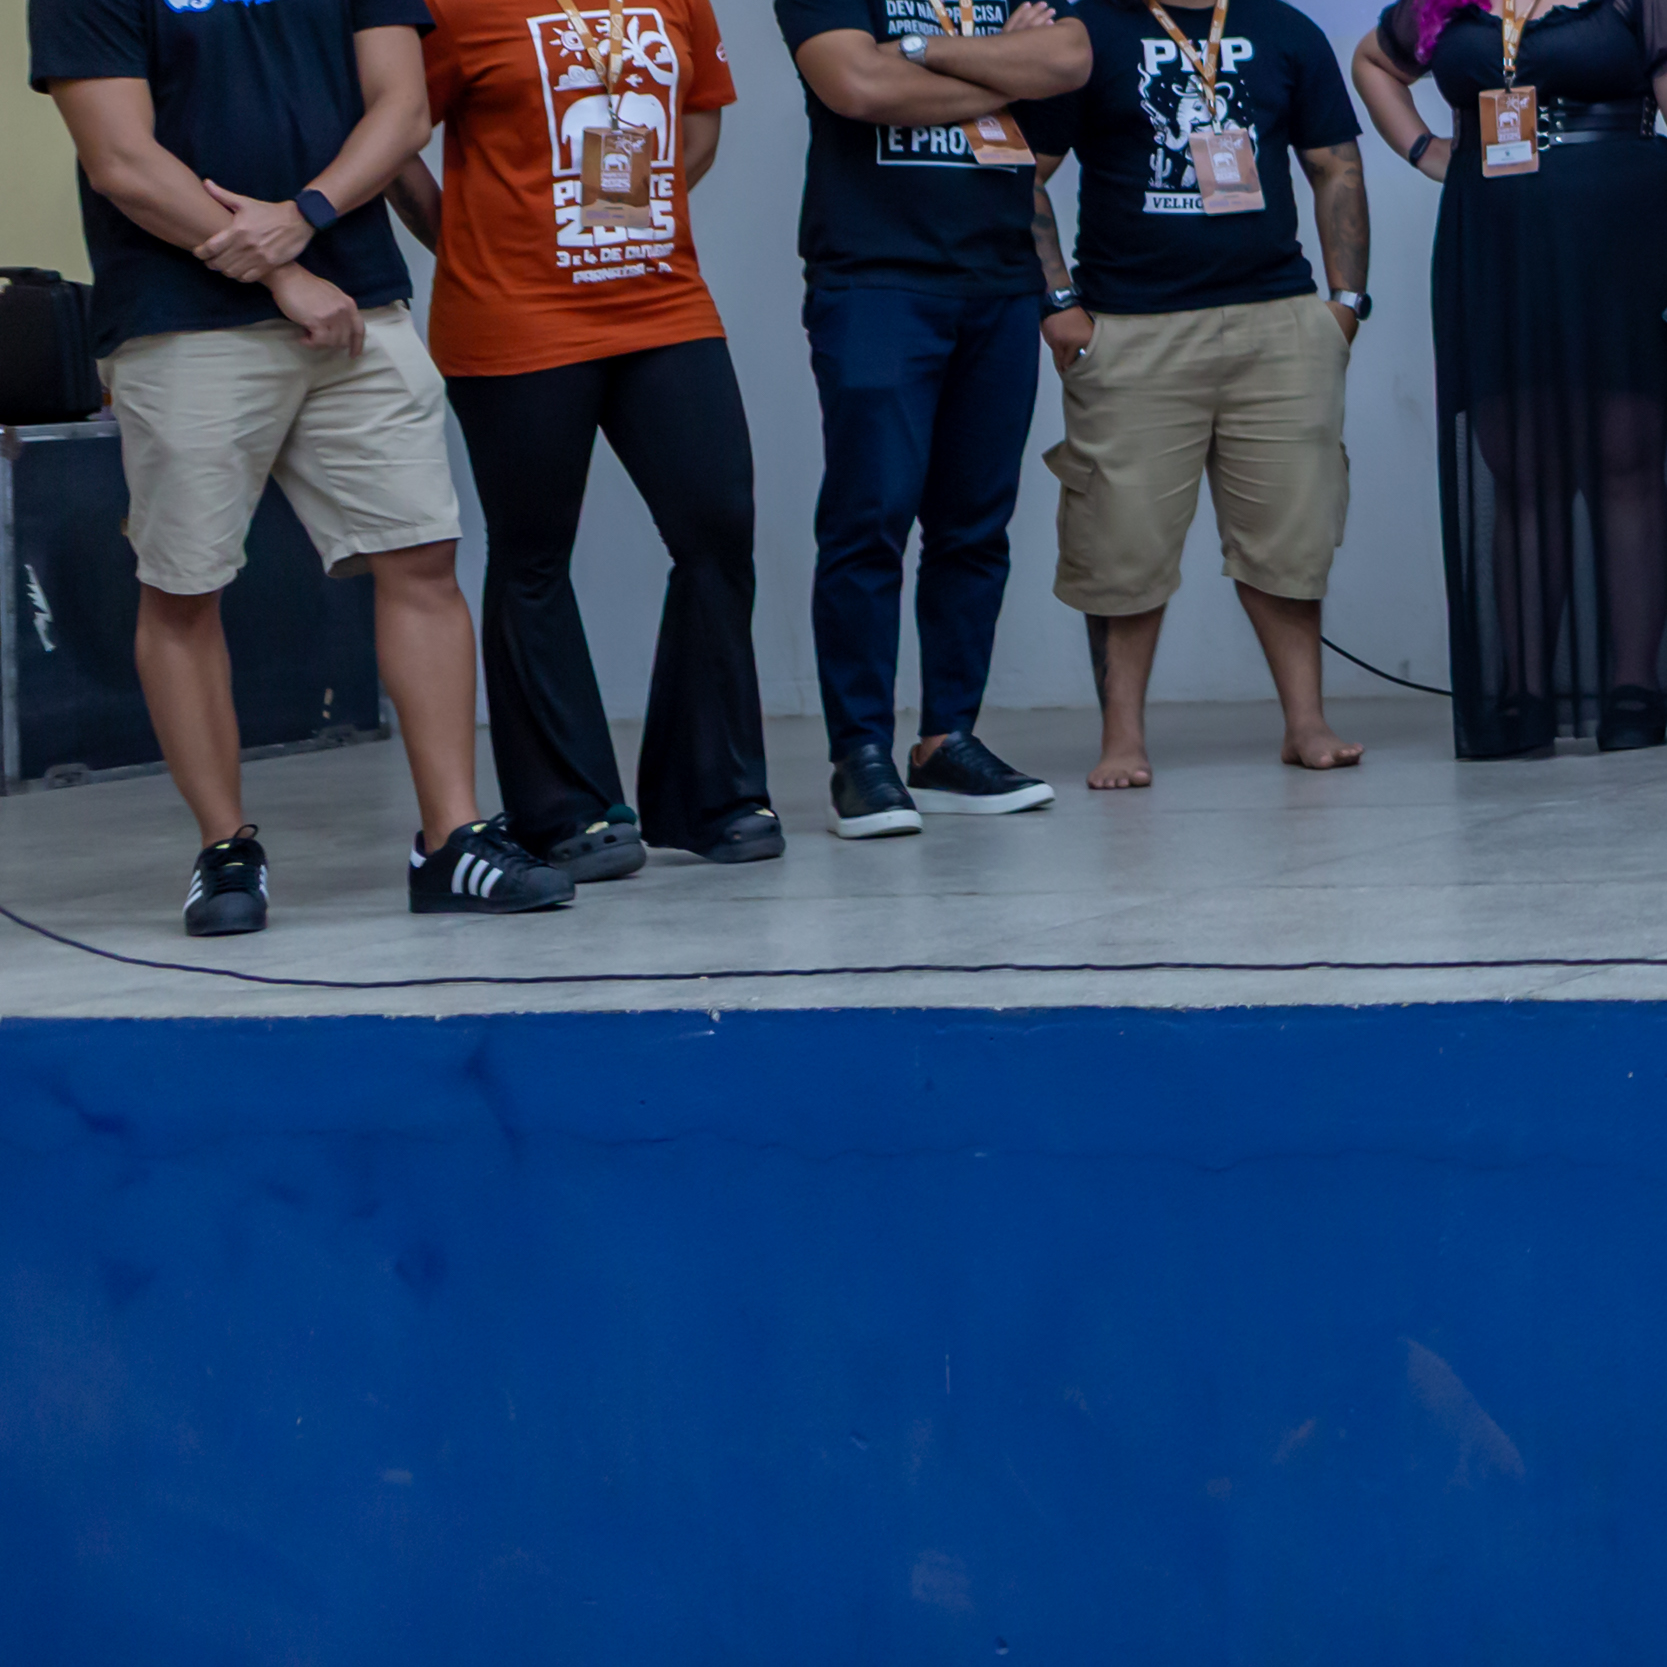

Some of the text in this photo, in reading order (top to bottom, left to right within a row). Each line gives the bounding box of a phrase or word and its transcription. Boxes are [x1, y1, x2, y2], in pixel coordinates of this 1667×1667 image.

[886, 0, 914, 16] DEV
[556, 251, 571, 267] 3
[600, 248, 623, 263] DE
